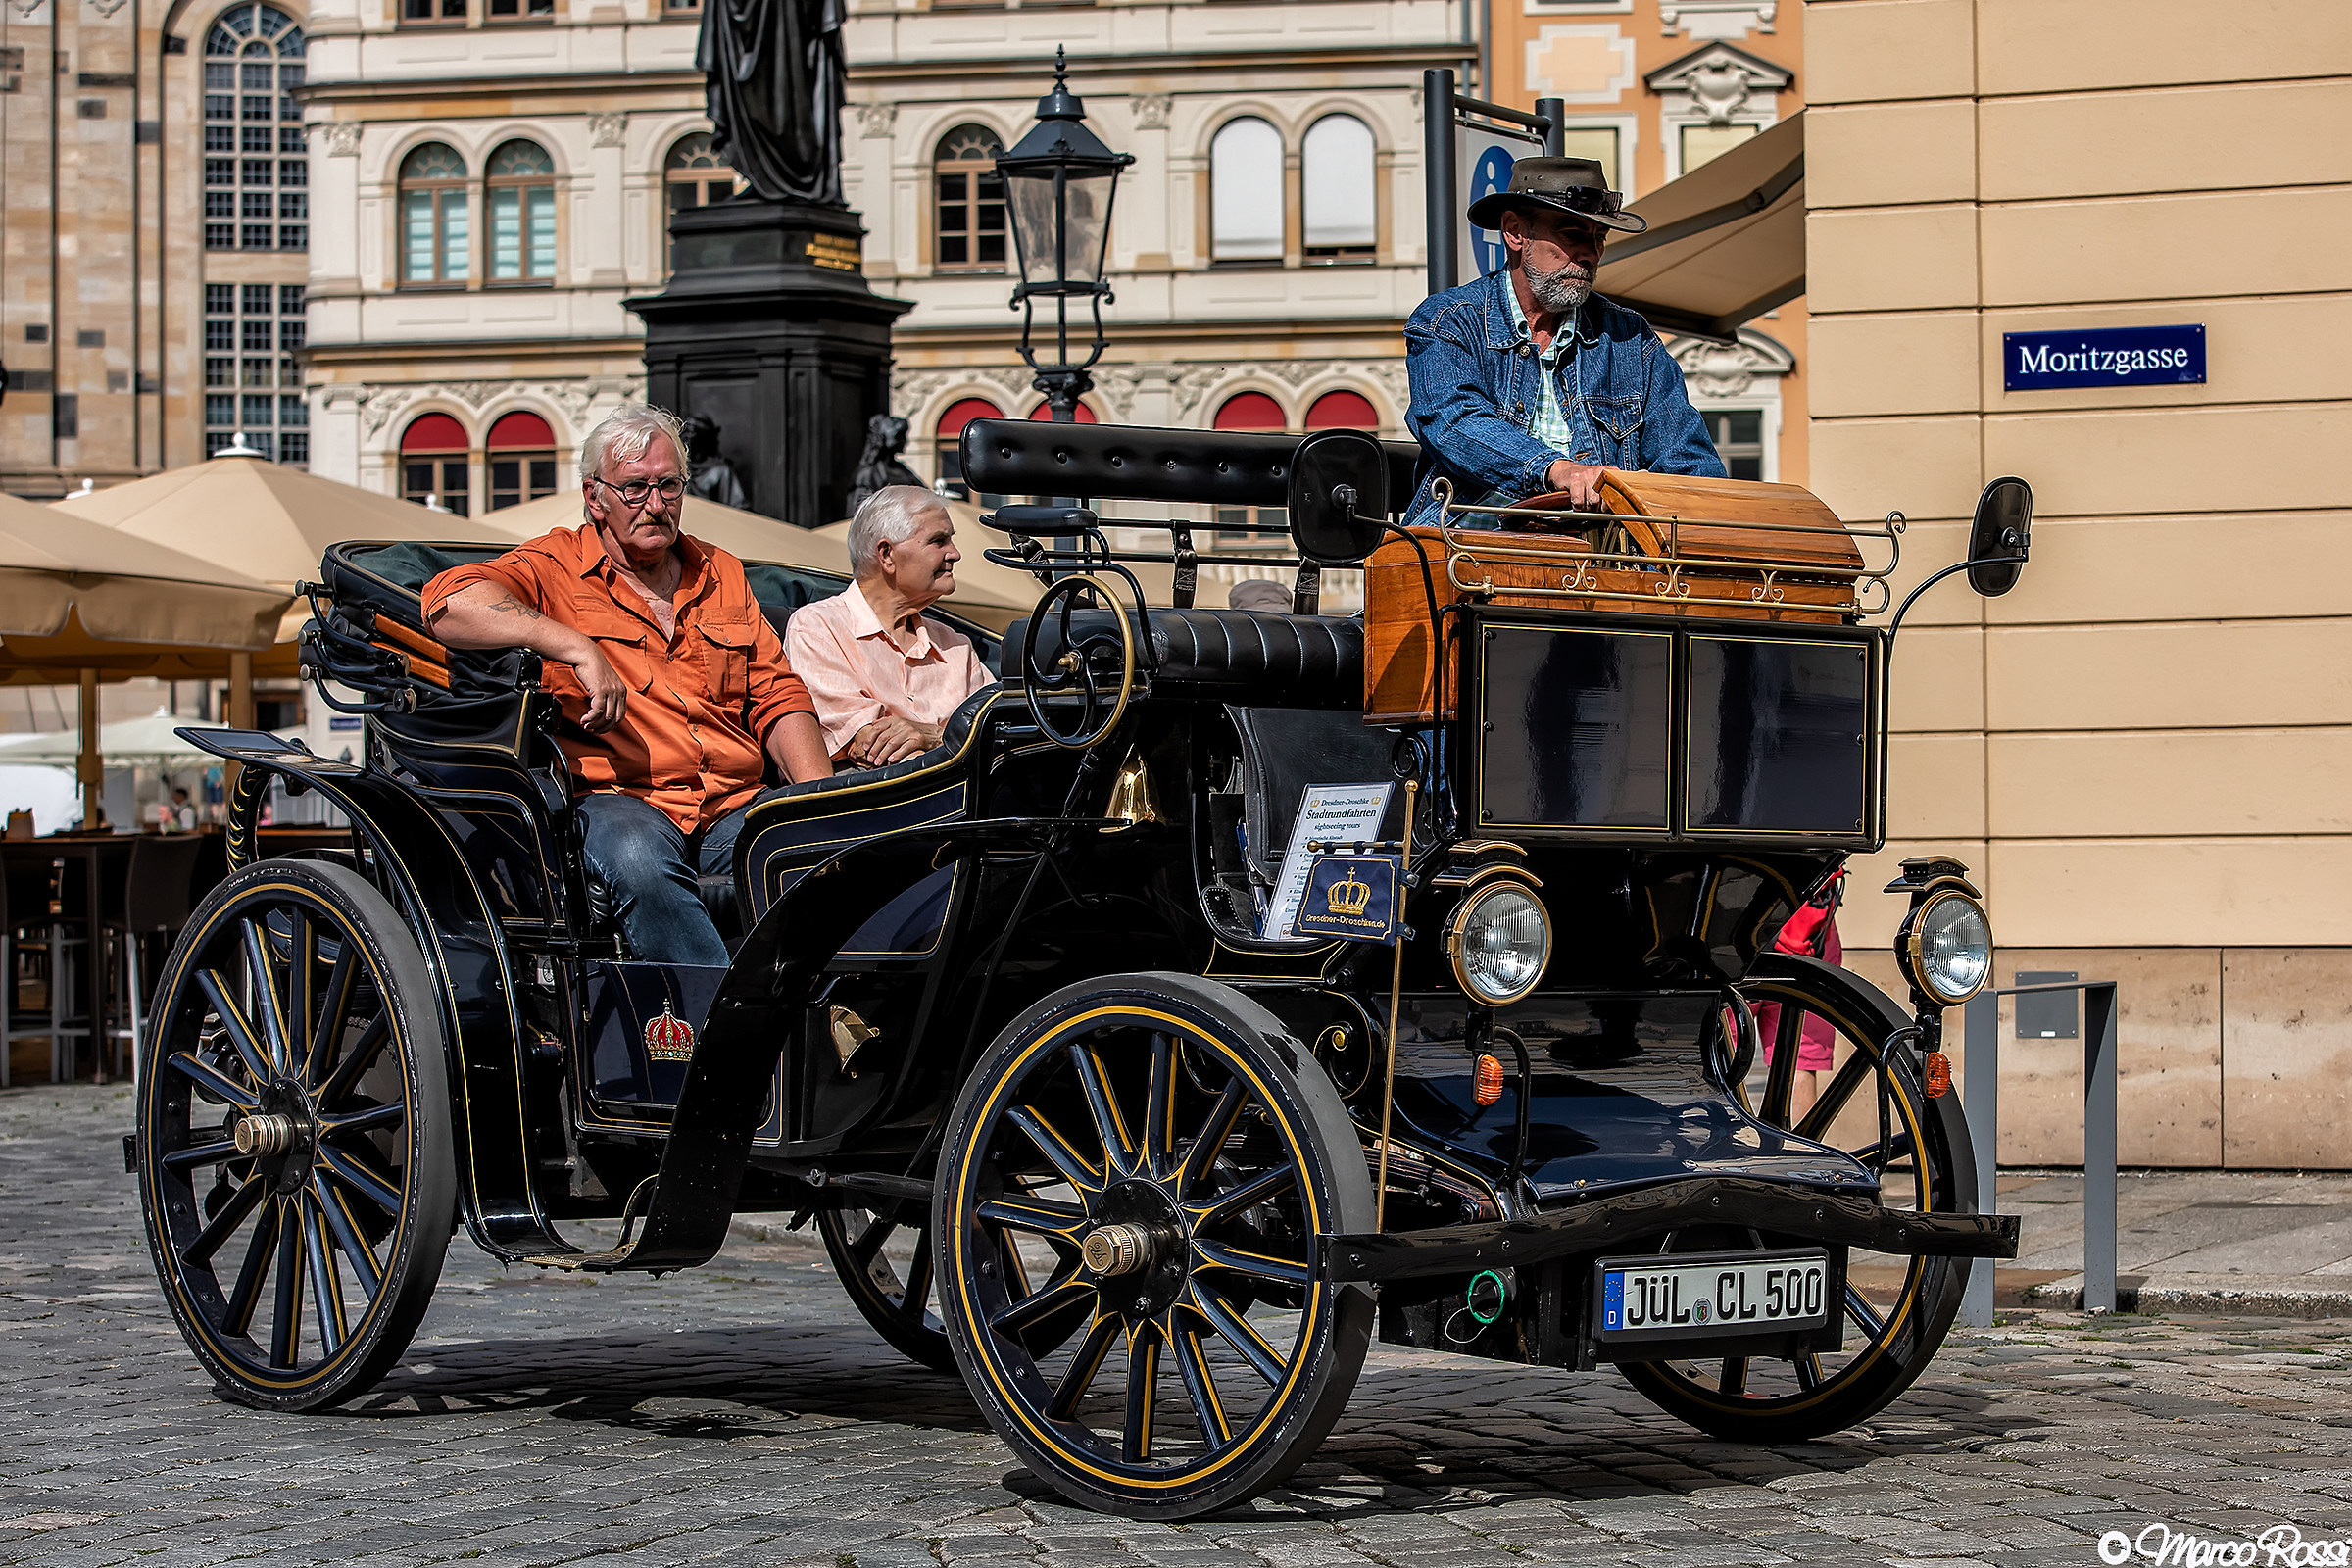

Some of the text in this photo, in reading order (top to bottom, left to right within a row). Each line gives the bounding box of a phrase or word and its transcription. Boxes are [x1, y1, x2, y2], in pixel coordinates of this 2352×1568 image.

[2019, 343, 2188, 375] Moritzgasse
[1306, 808, 1376, 819] Stadtrundfahrten
[1627, 1267, 1822, 1326] JÜL CL 500
[1608, 1310, 1617, 1325] D
